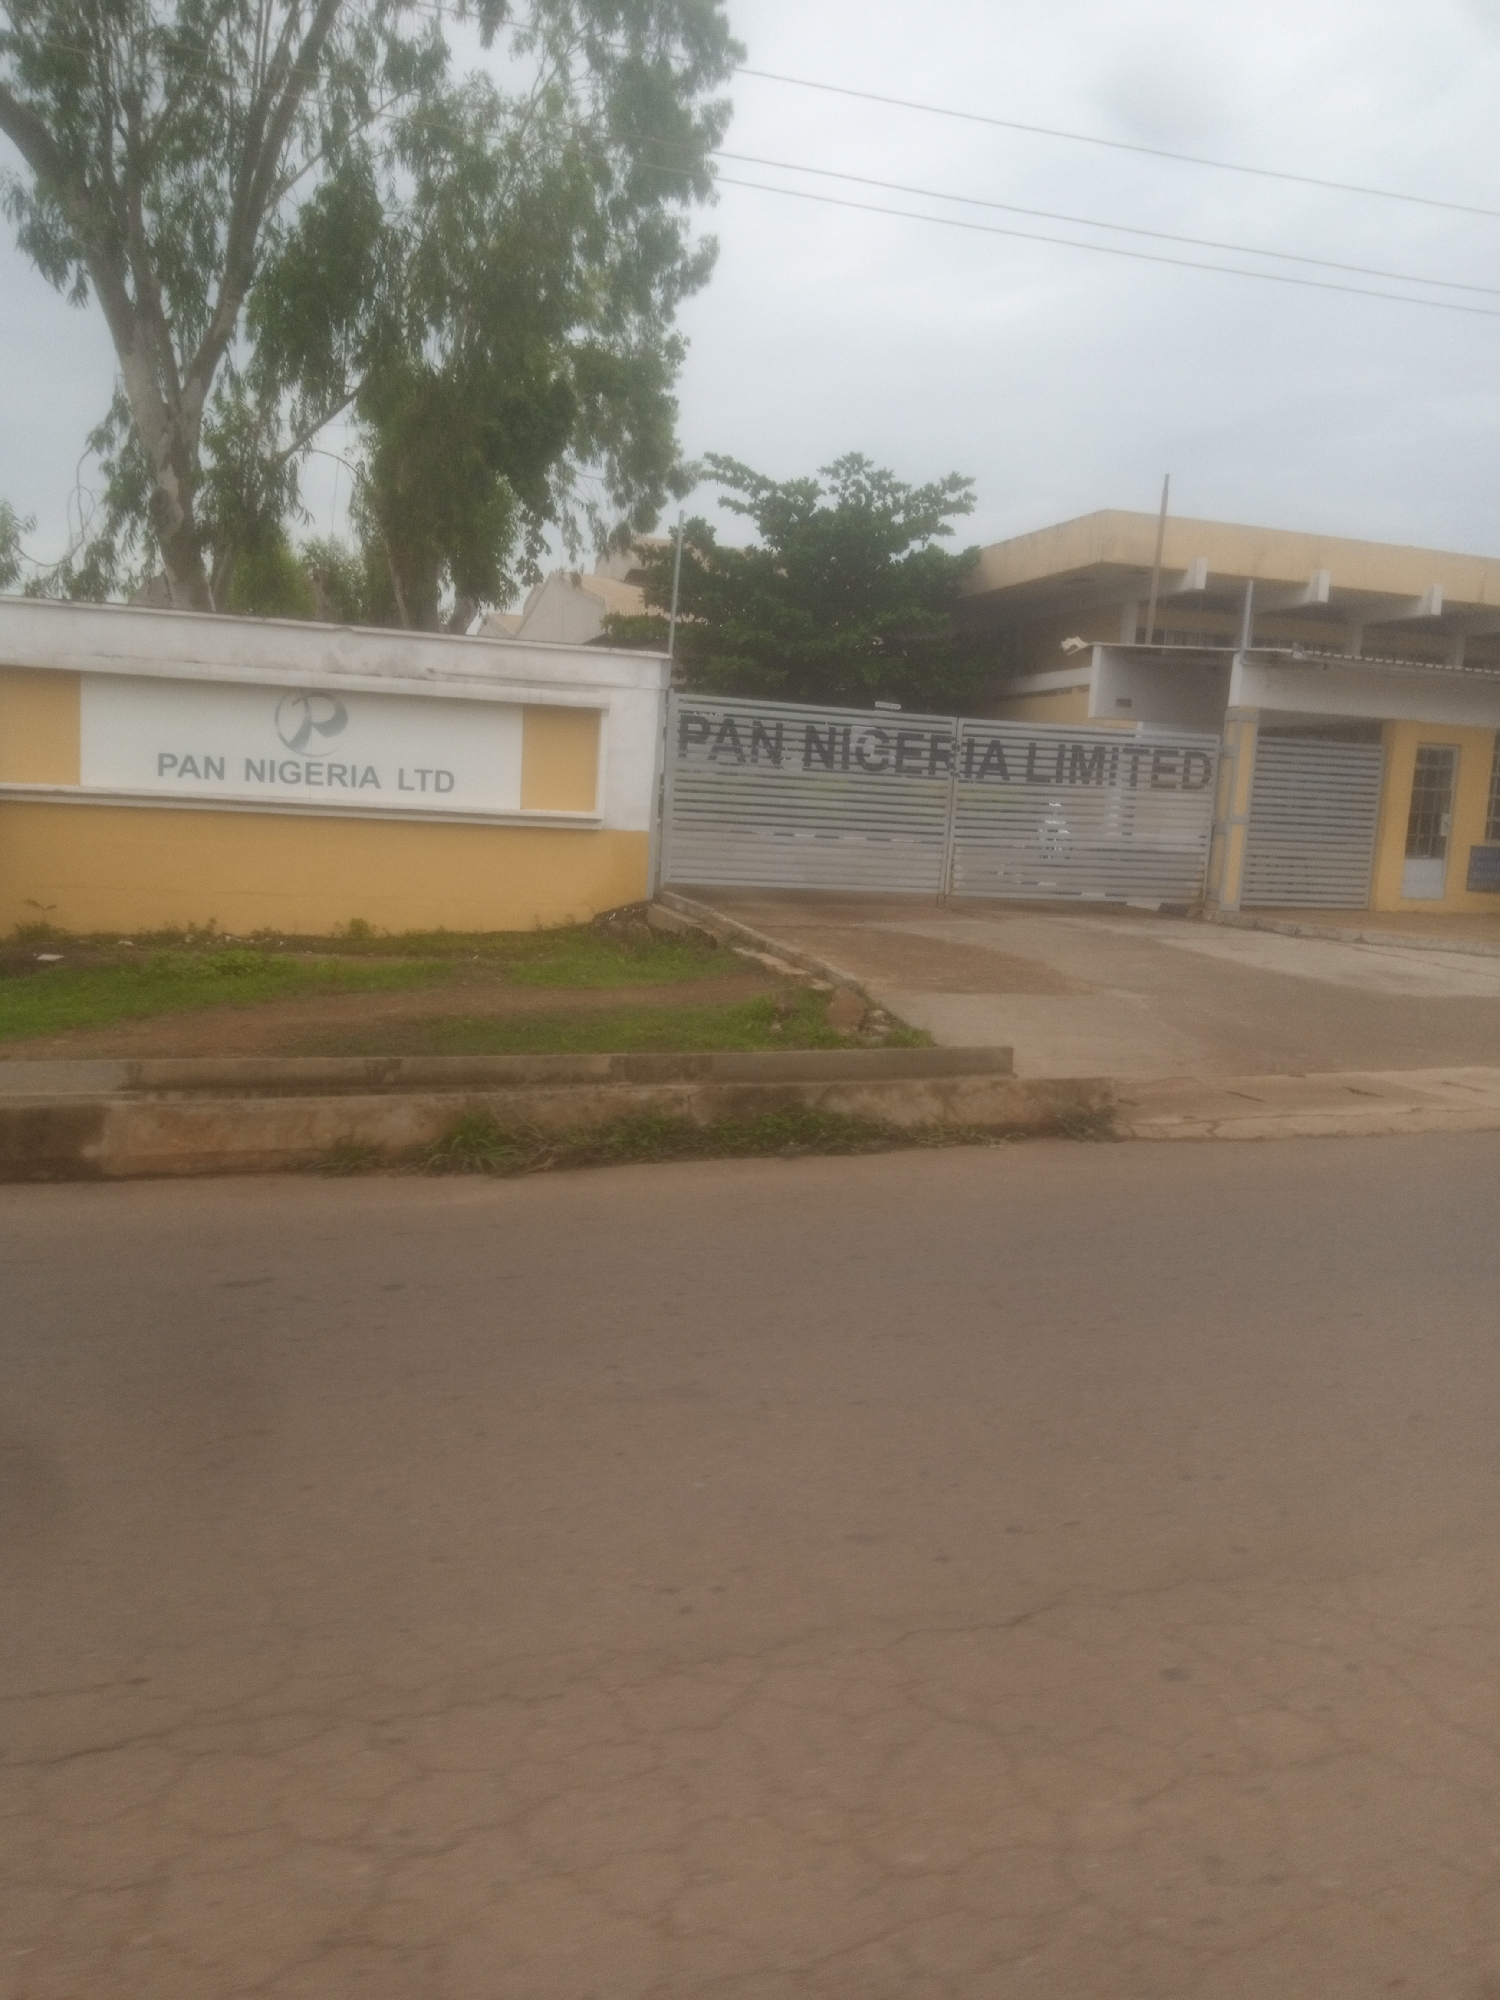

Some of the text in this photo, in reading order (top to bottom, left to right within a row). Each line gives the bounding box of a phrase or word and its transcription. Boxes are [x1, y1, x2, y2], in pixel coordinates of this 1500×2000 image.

[157, 752, 455, 794] PAN NIGERIA LTD
[678, 713, 1213, 790] PAN NIGERIA LIMITED
